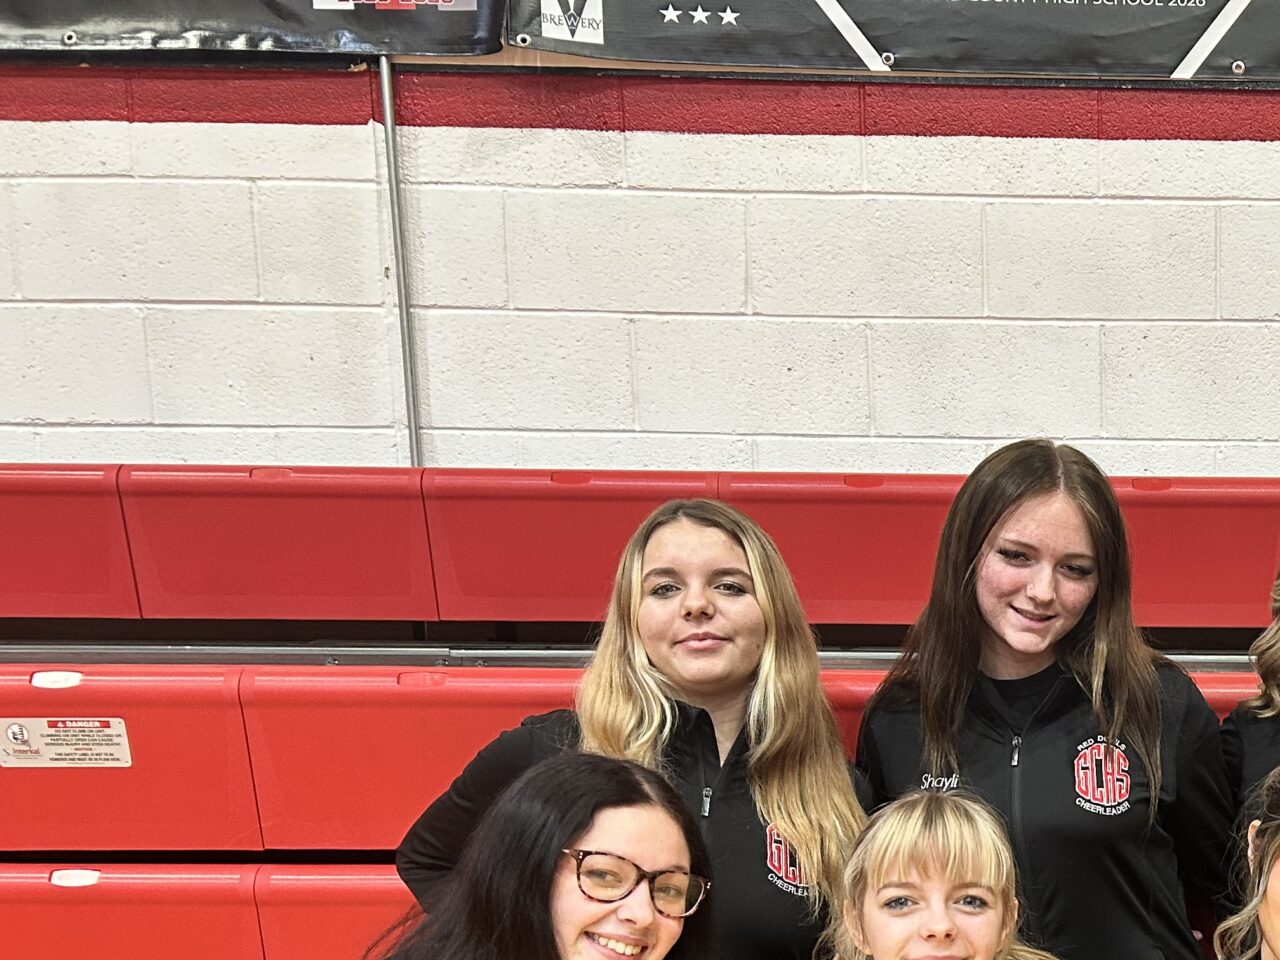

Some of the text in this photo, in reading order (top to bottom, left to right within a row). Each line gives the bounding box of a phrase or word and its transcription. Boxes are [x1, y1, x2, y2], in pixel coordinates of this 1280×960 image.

[542, 11, 602, 31] BREWERY
[1076, 738, 1095, 751] RED
[920, 773, 960, 792] Shayli
[1074, 743, 1130, 806] GCHS
[1075, 797, 1131, 816] CHEERLEADER
